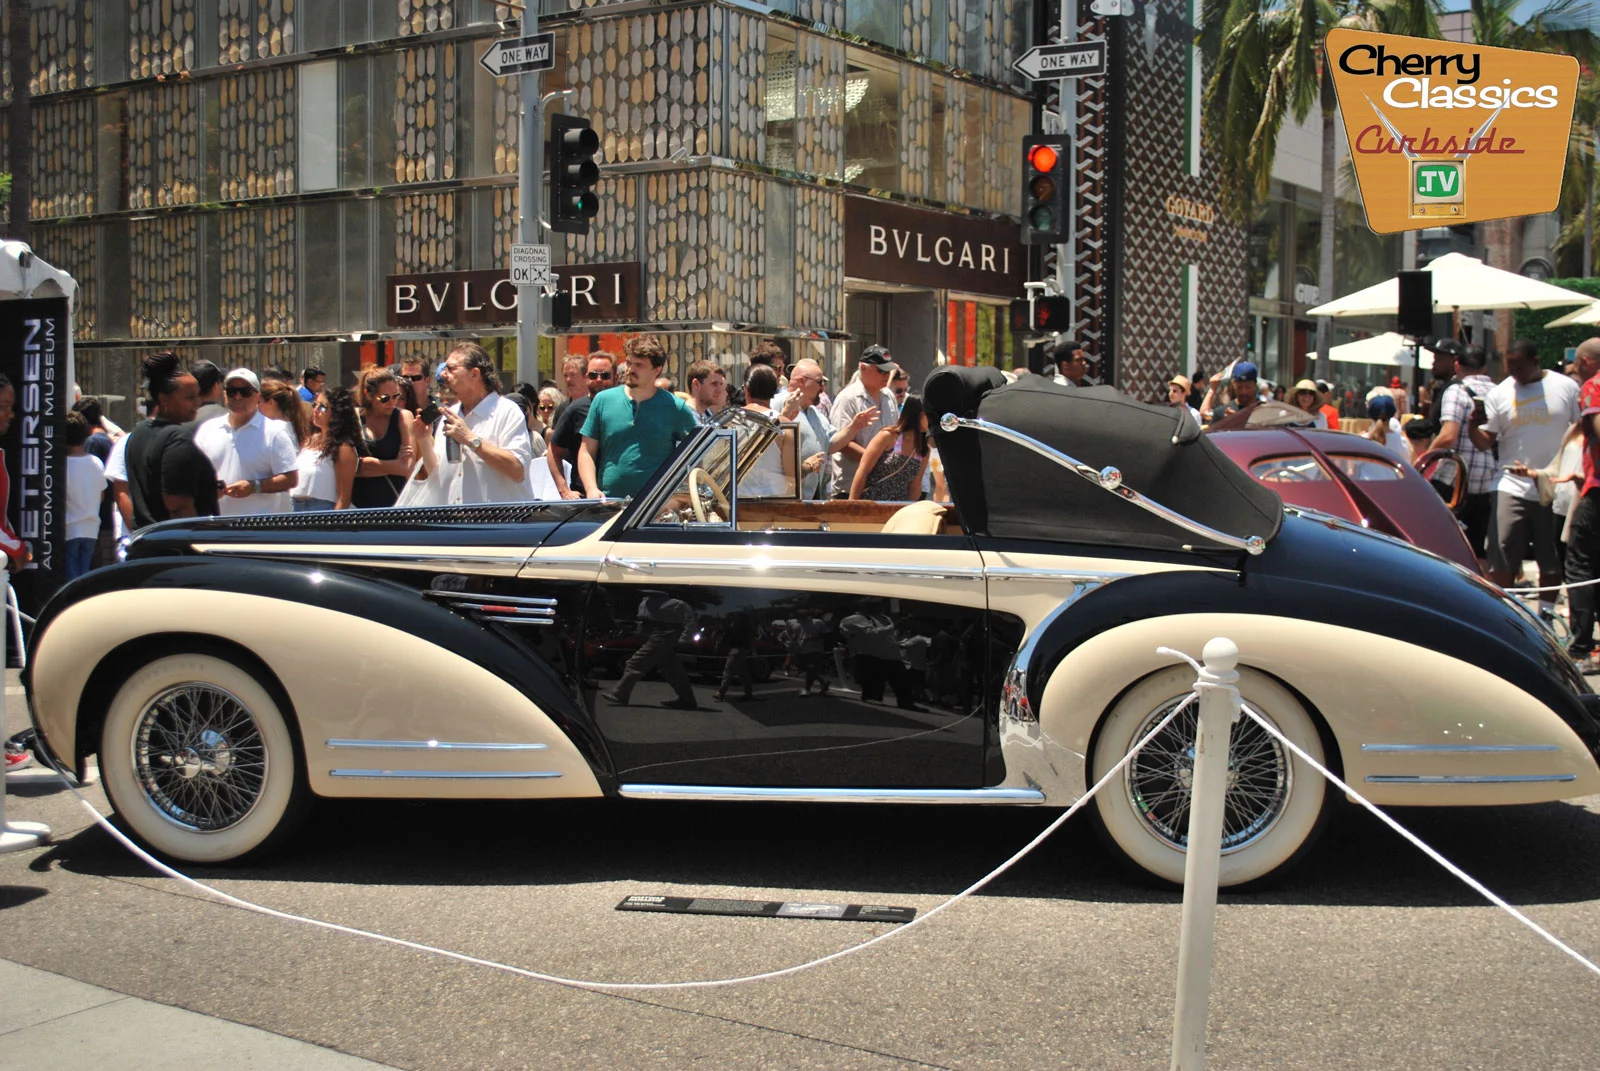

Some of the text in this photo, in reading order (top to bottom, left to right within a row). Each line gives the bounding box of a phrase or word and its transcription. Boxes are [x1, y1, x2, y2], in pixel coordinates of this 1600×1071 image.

[501, 45, 546, 64] ONE WAY
[1040, 52, 1095, 69] ONE WAY
[513, 247, 547, 255] DIAGONAL
[869, 224, 1010, 275] BVLGARI
[513, 267, 529, 281] OK
[395, 273, 622, 314] BVLGRI
[42, 318, 55, 570] AUTOMOTIVE MUSEUM
